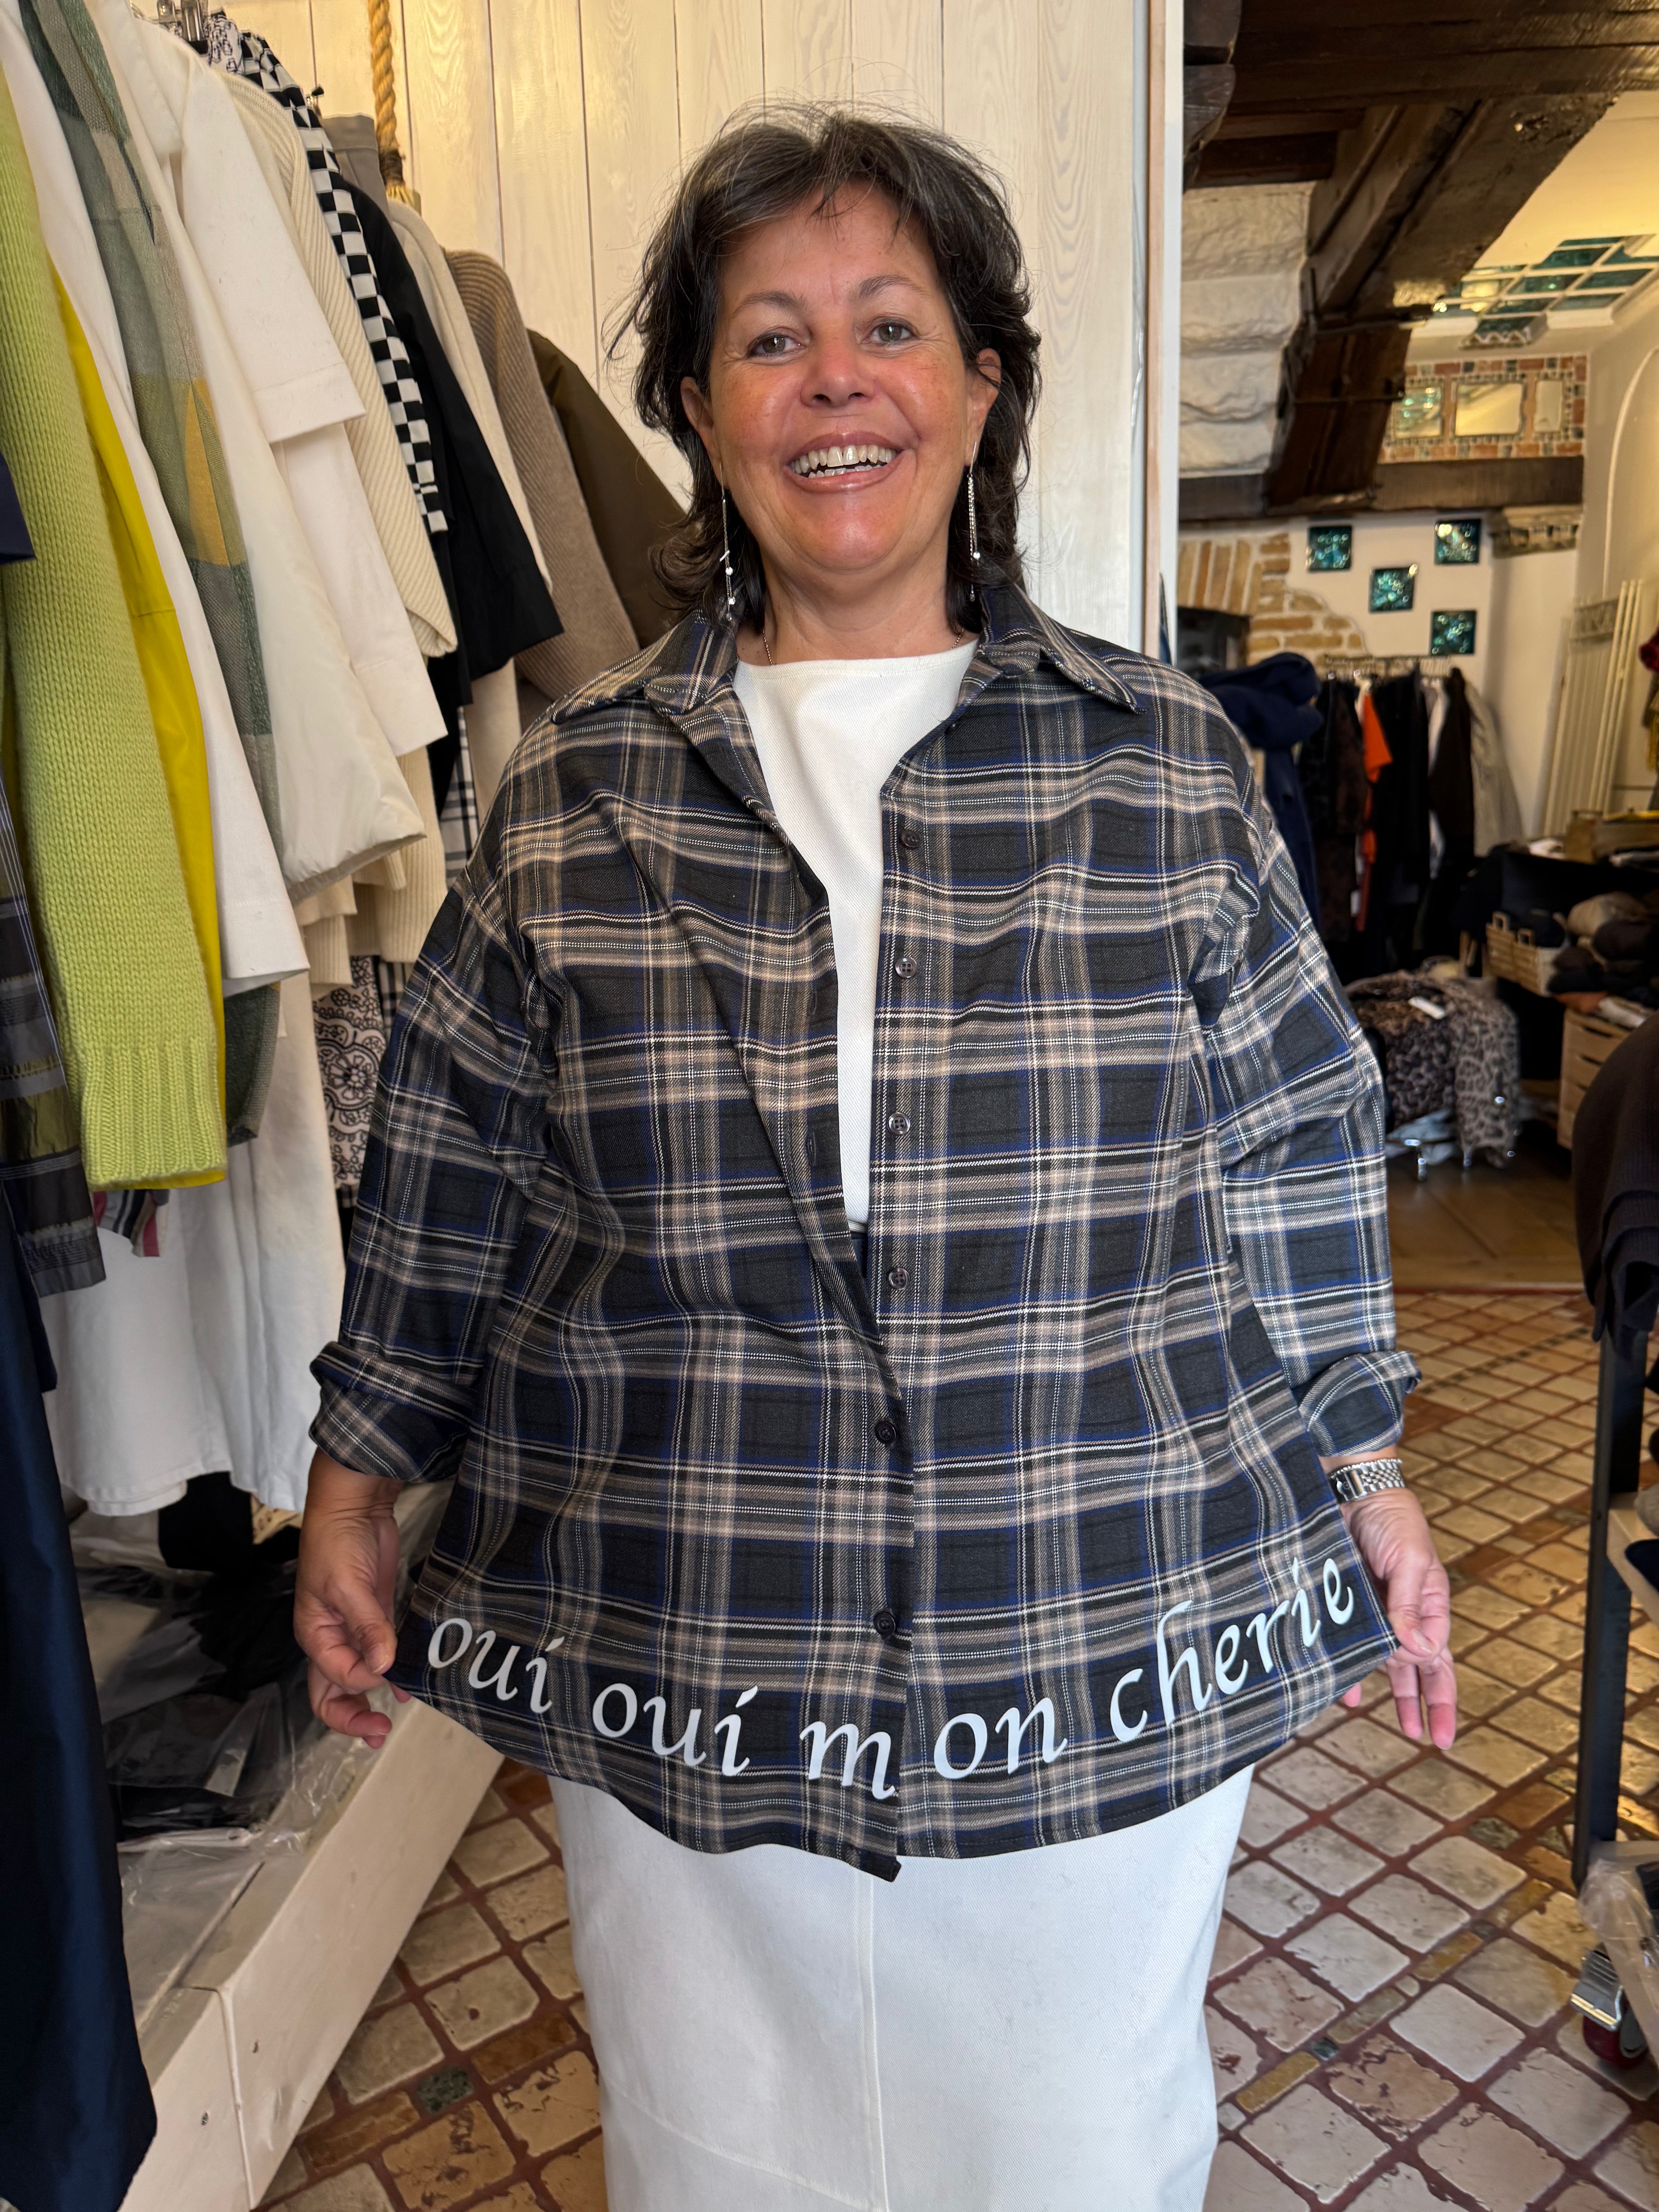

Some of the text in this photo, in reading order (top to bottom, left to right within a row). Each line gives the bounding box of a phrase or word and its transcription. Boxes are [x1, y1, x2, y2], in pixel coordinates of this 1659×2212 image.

[428, 1618, 565, 1713] oui
[592, 1683, 758, 1776] oui
[1110, 1557, 1354, 1743] cherie
